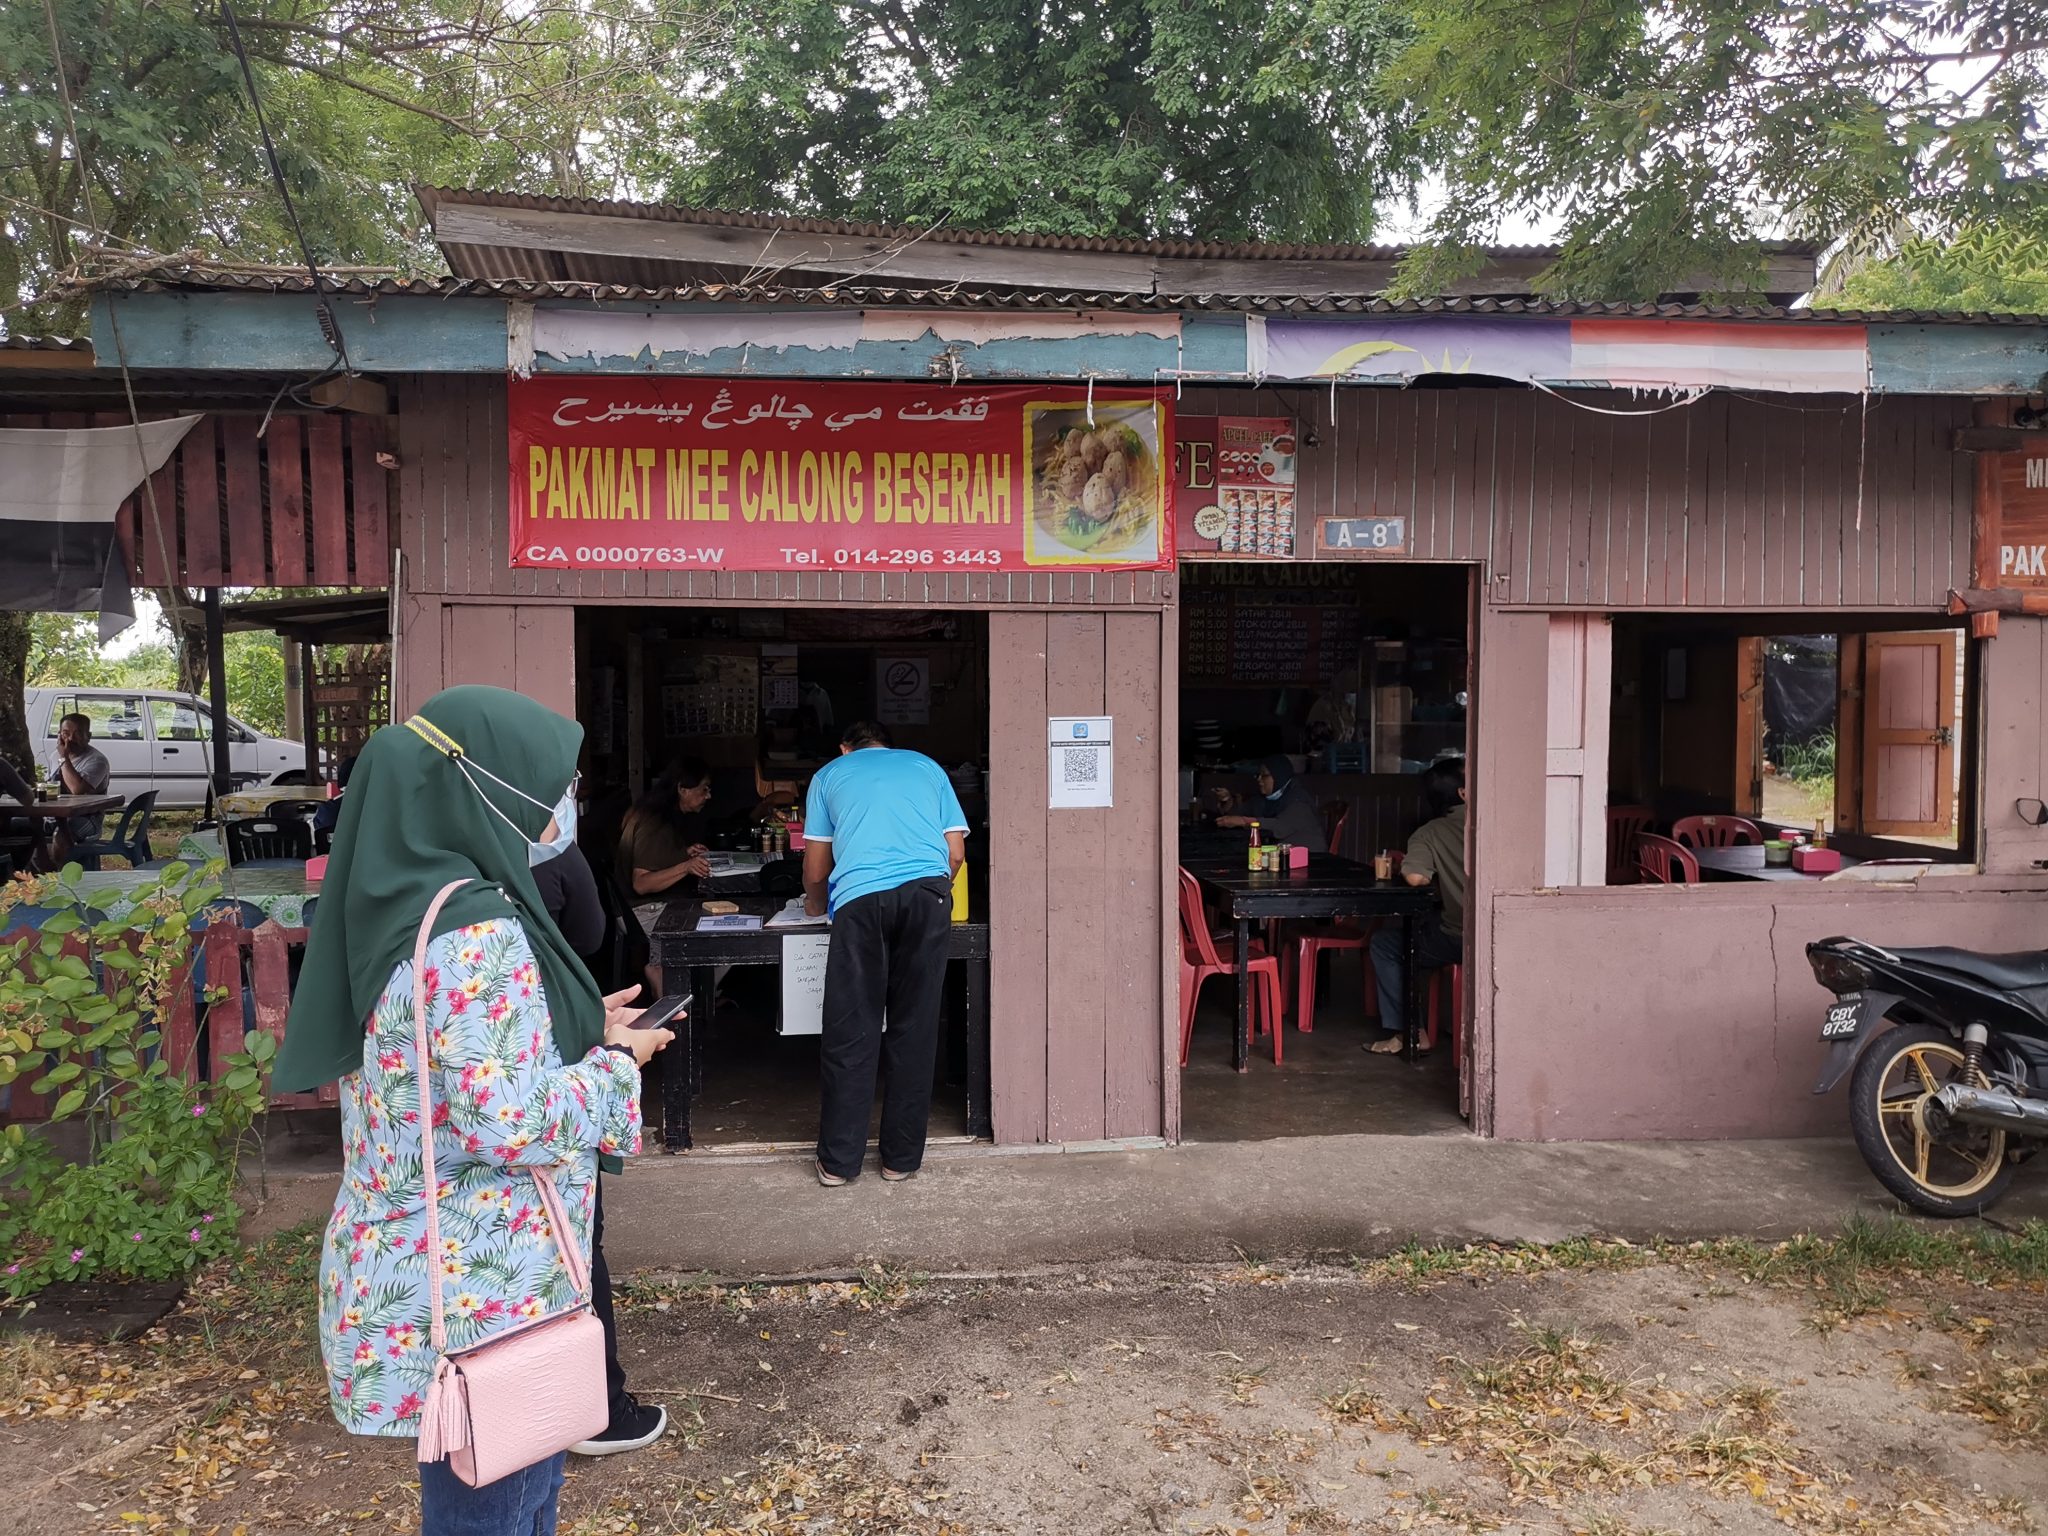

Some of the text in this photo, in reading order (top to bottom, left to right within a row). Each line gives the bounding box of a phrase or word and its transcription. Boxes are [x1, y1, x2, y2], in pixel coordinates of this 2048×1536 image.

[824, 406, 883, 432] مي
[529, 446, 1011, 524] PAKMAT MEE CALONG BESERAH
[527, 546, 725, 564] CA 0000763-W
[780, 548, 1002, 565] Tel. 014-296 3443
[2001, 545, 2046, 576] PAK
[1830, 1005, 1857, 1022] CBY
[1822, 1018, 1857, 1036] 8732
